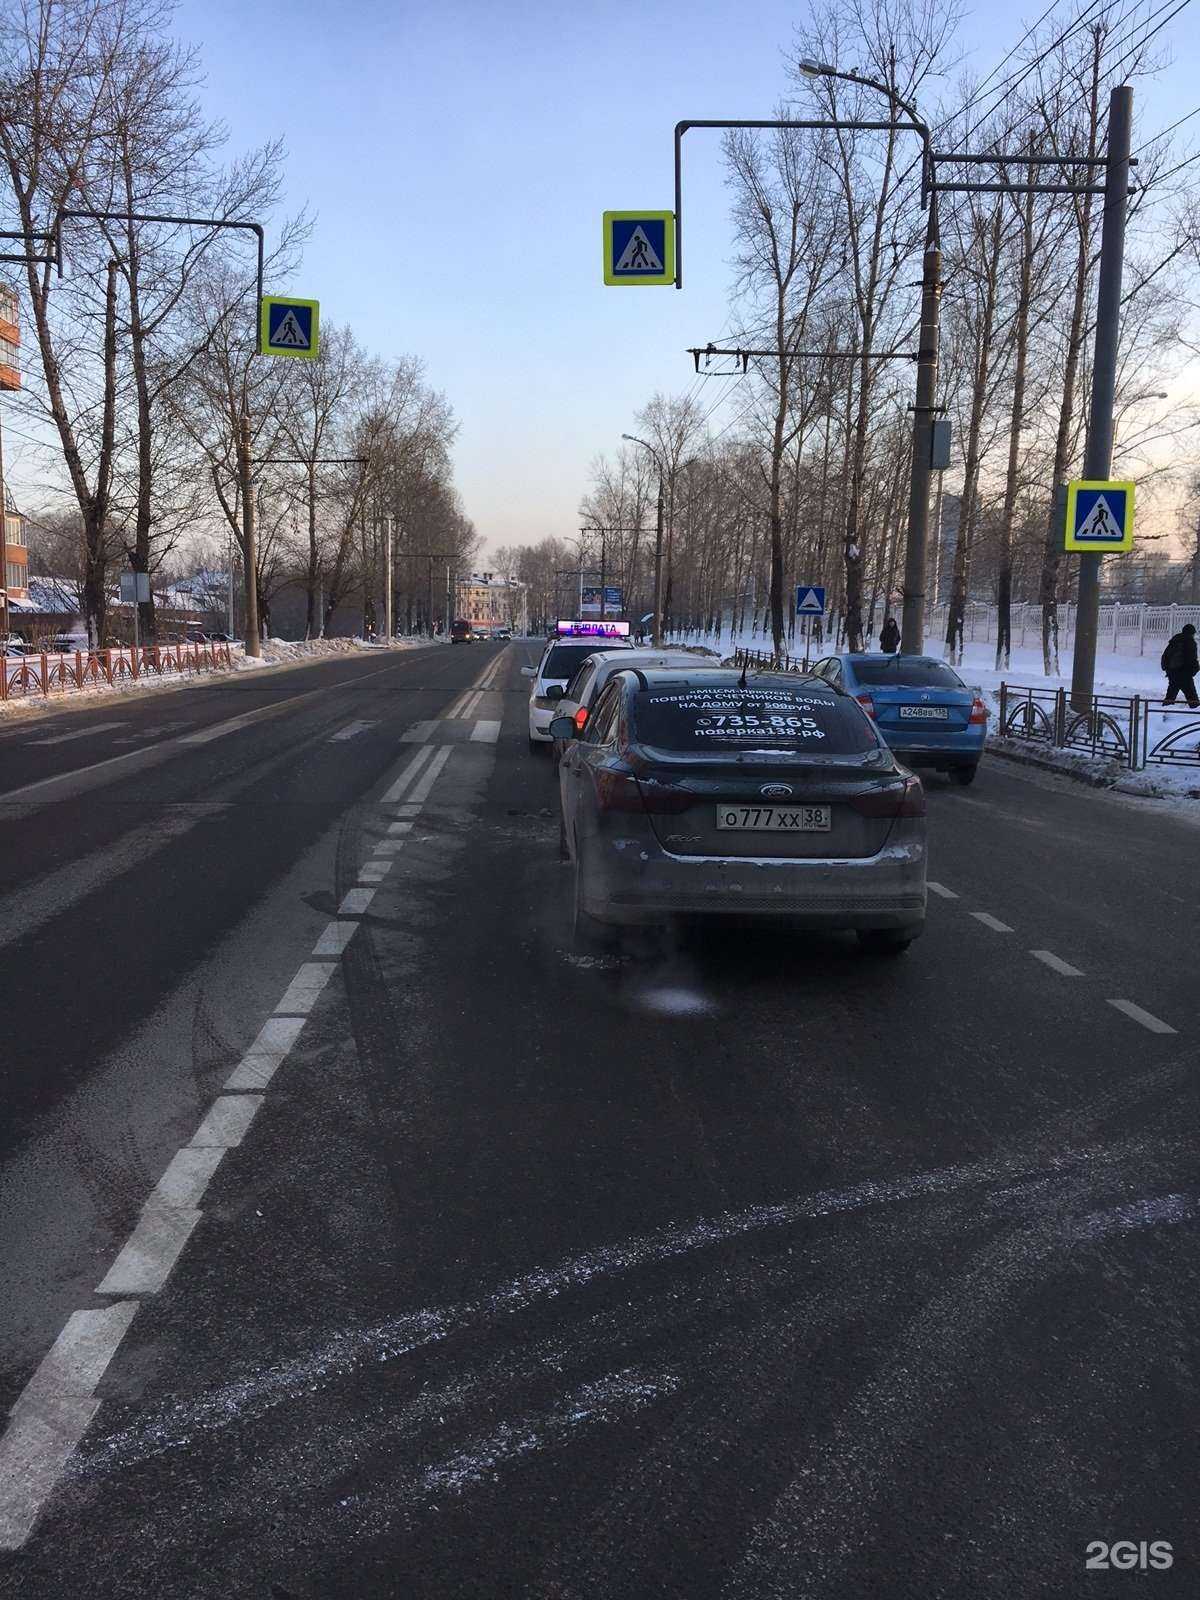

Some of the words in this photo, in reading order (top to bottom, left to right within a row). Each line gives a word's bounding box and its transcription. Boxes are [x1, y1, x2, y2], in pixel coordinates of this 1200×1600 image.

[650, 694, 712, 703] ПОВЕРКА
[715, 693, 792, 701] СЧЕТЧИКОВ
[795, 697, 835, 706] ВОДЫ
[701, 701, 743, 709] ДОМУ
[711, 715, 817, 728] 735-865
[694, 727, 825, 738] поверка138.рф
[805, 809, 823, 823] 38
